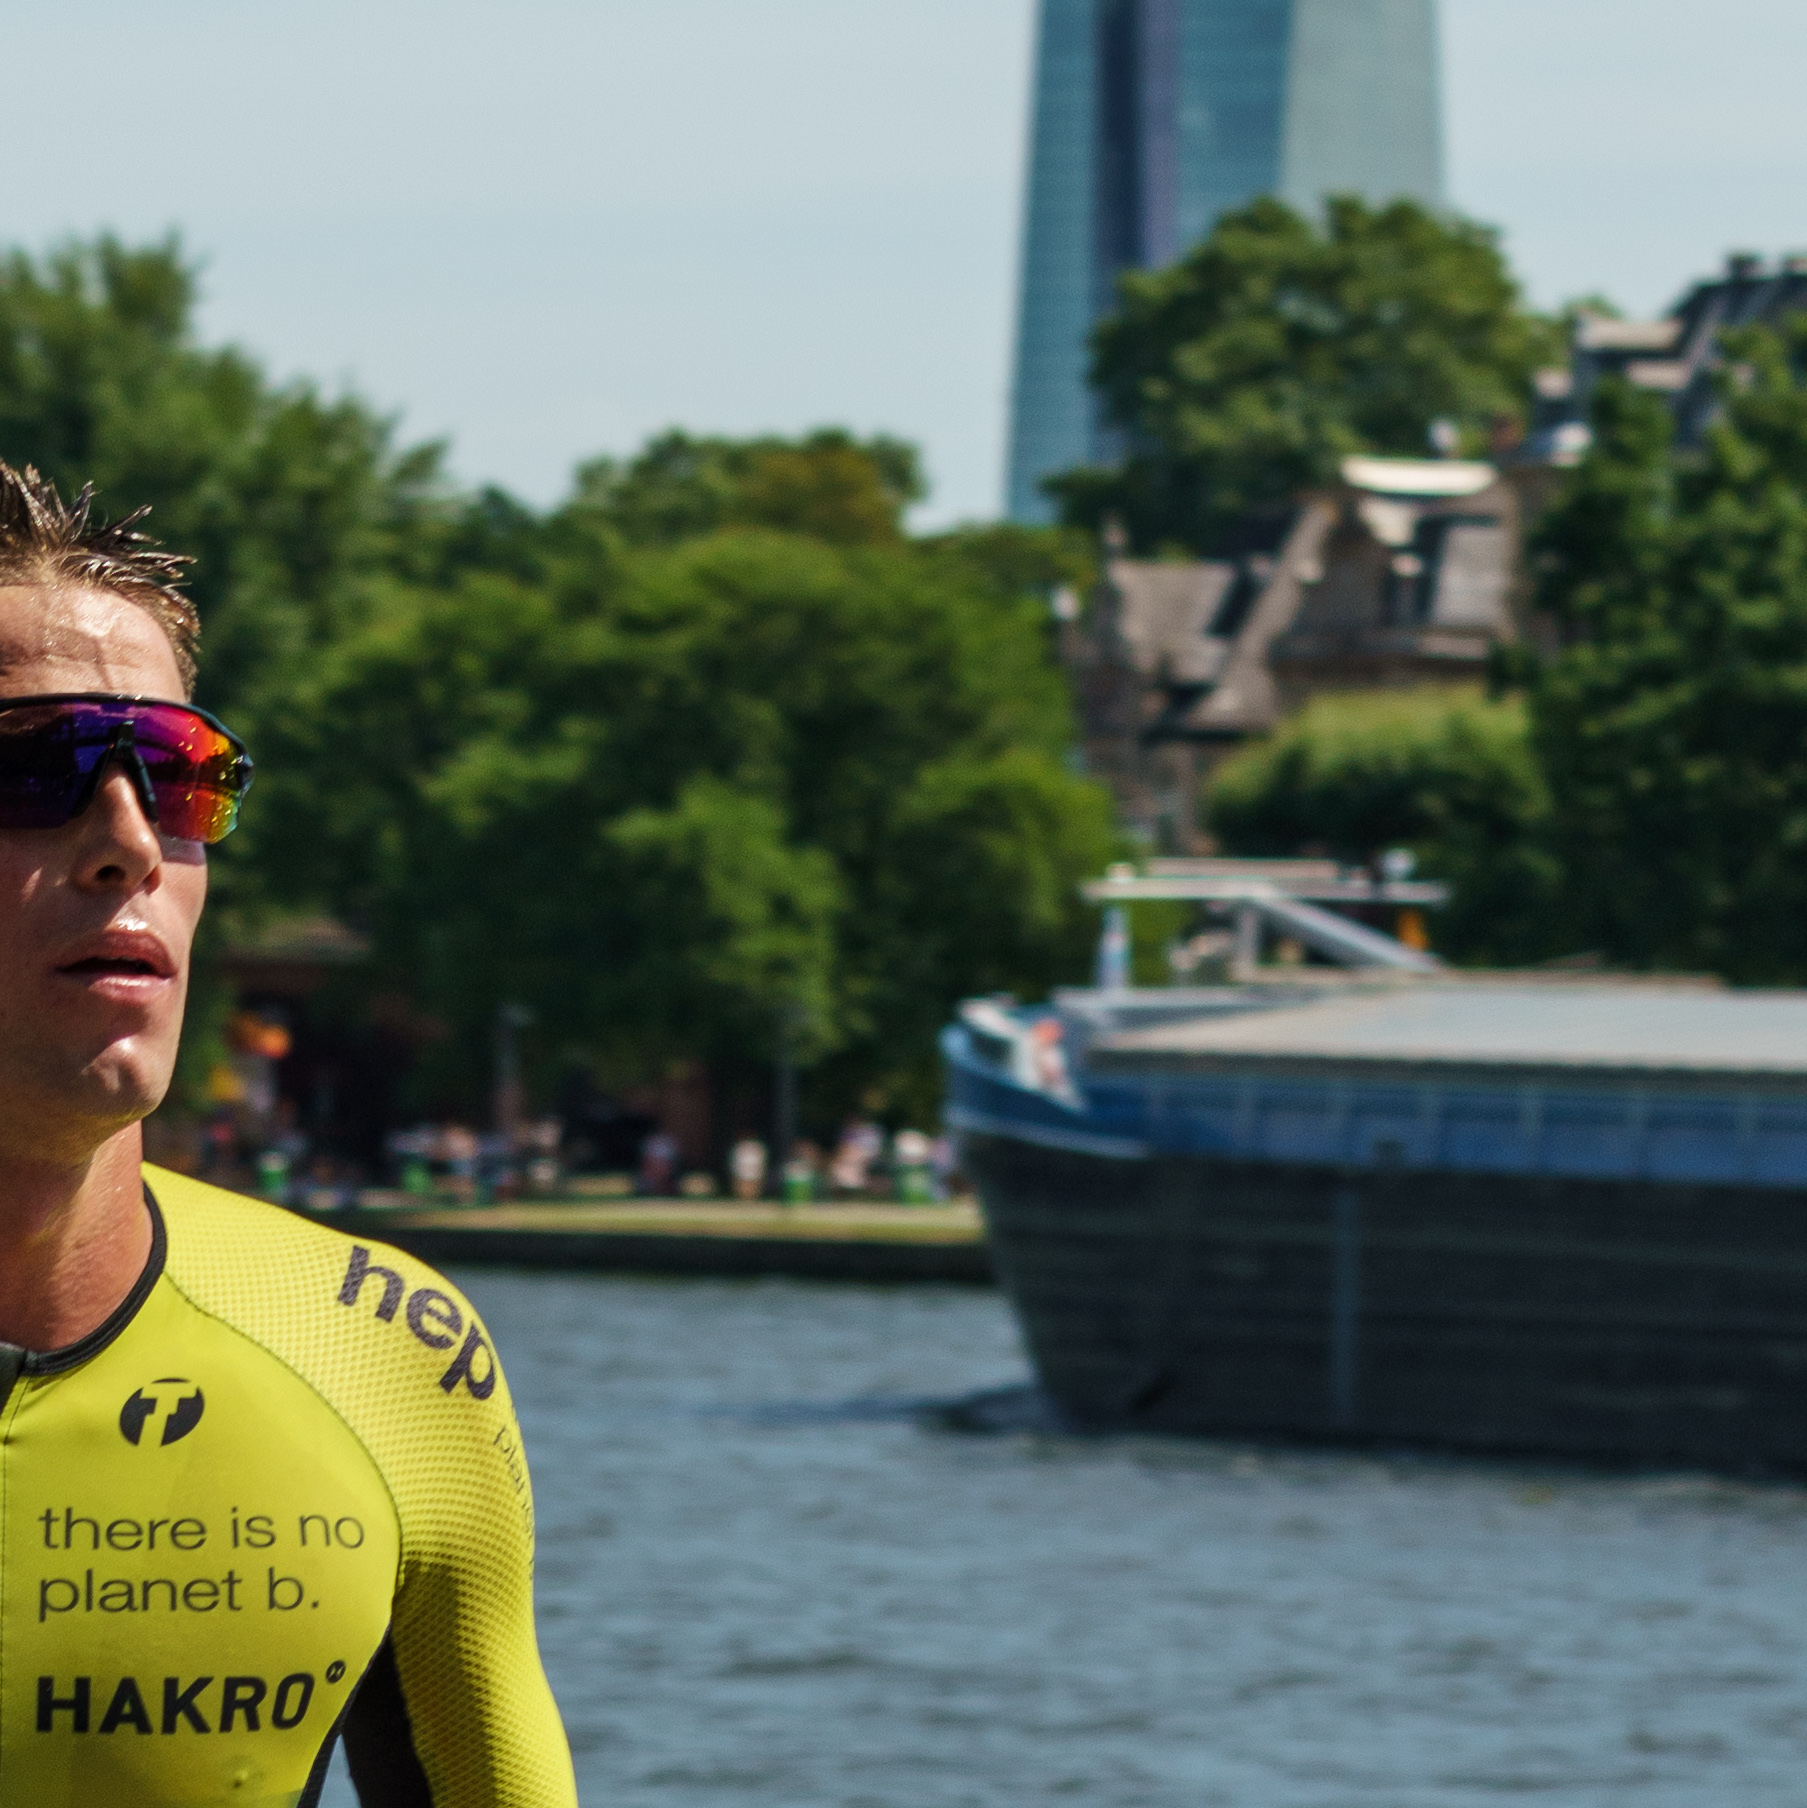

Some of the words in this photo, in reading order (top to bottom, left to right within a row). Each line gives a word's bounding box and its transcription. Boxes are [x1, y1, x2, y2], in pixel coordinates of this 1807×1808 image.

[337, 1244, 496, 1401] hep
[37, 1507, 207, 1551] there
[231, 1506, 277, 1550] is
[298, 1514, 365, 1550] no
[38, 1568, 242, 1624] planet
[267, 1566, 321, 1612] b.
[35, 1672, 315, 1735] HAKRO
